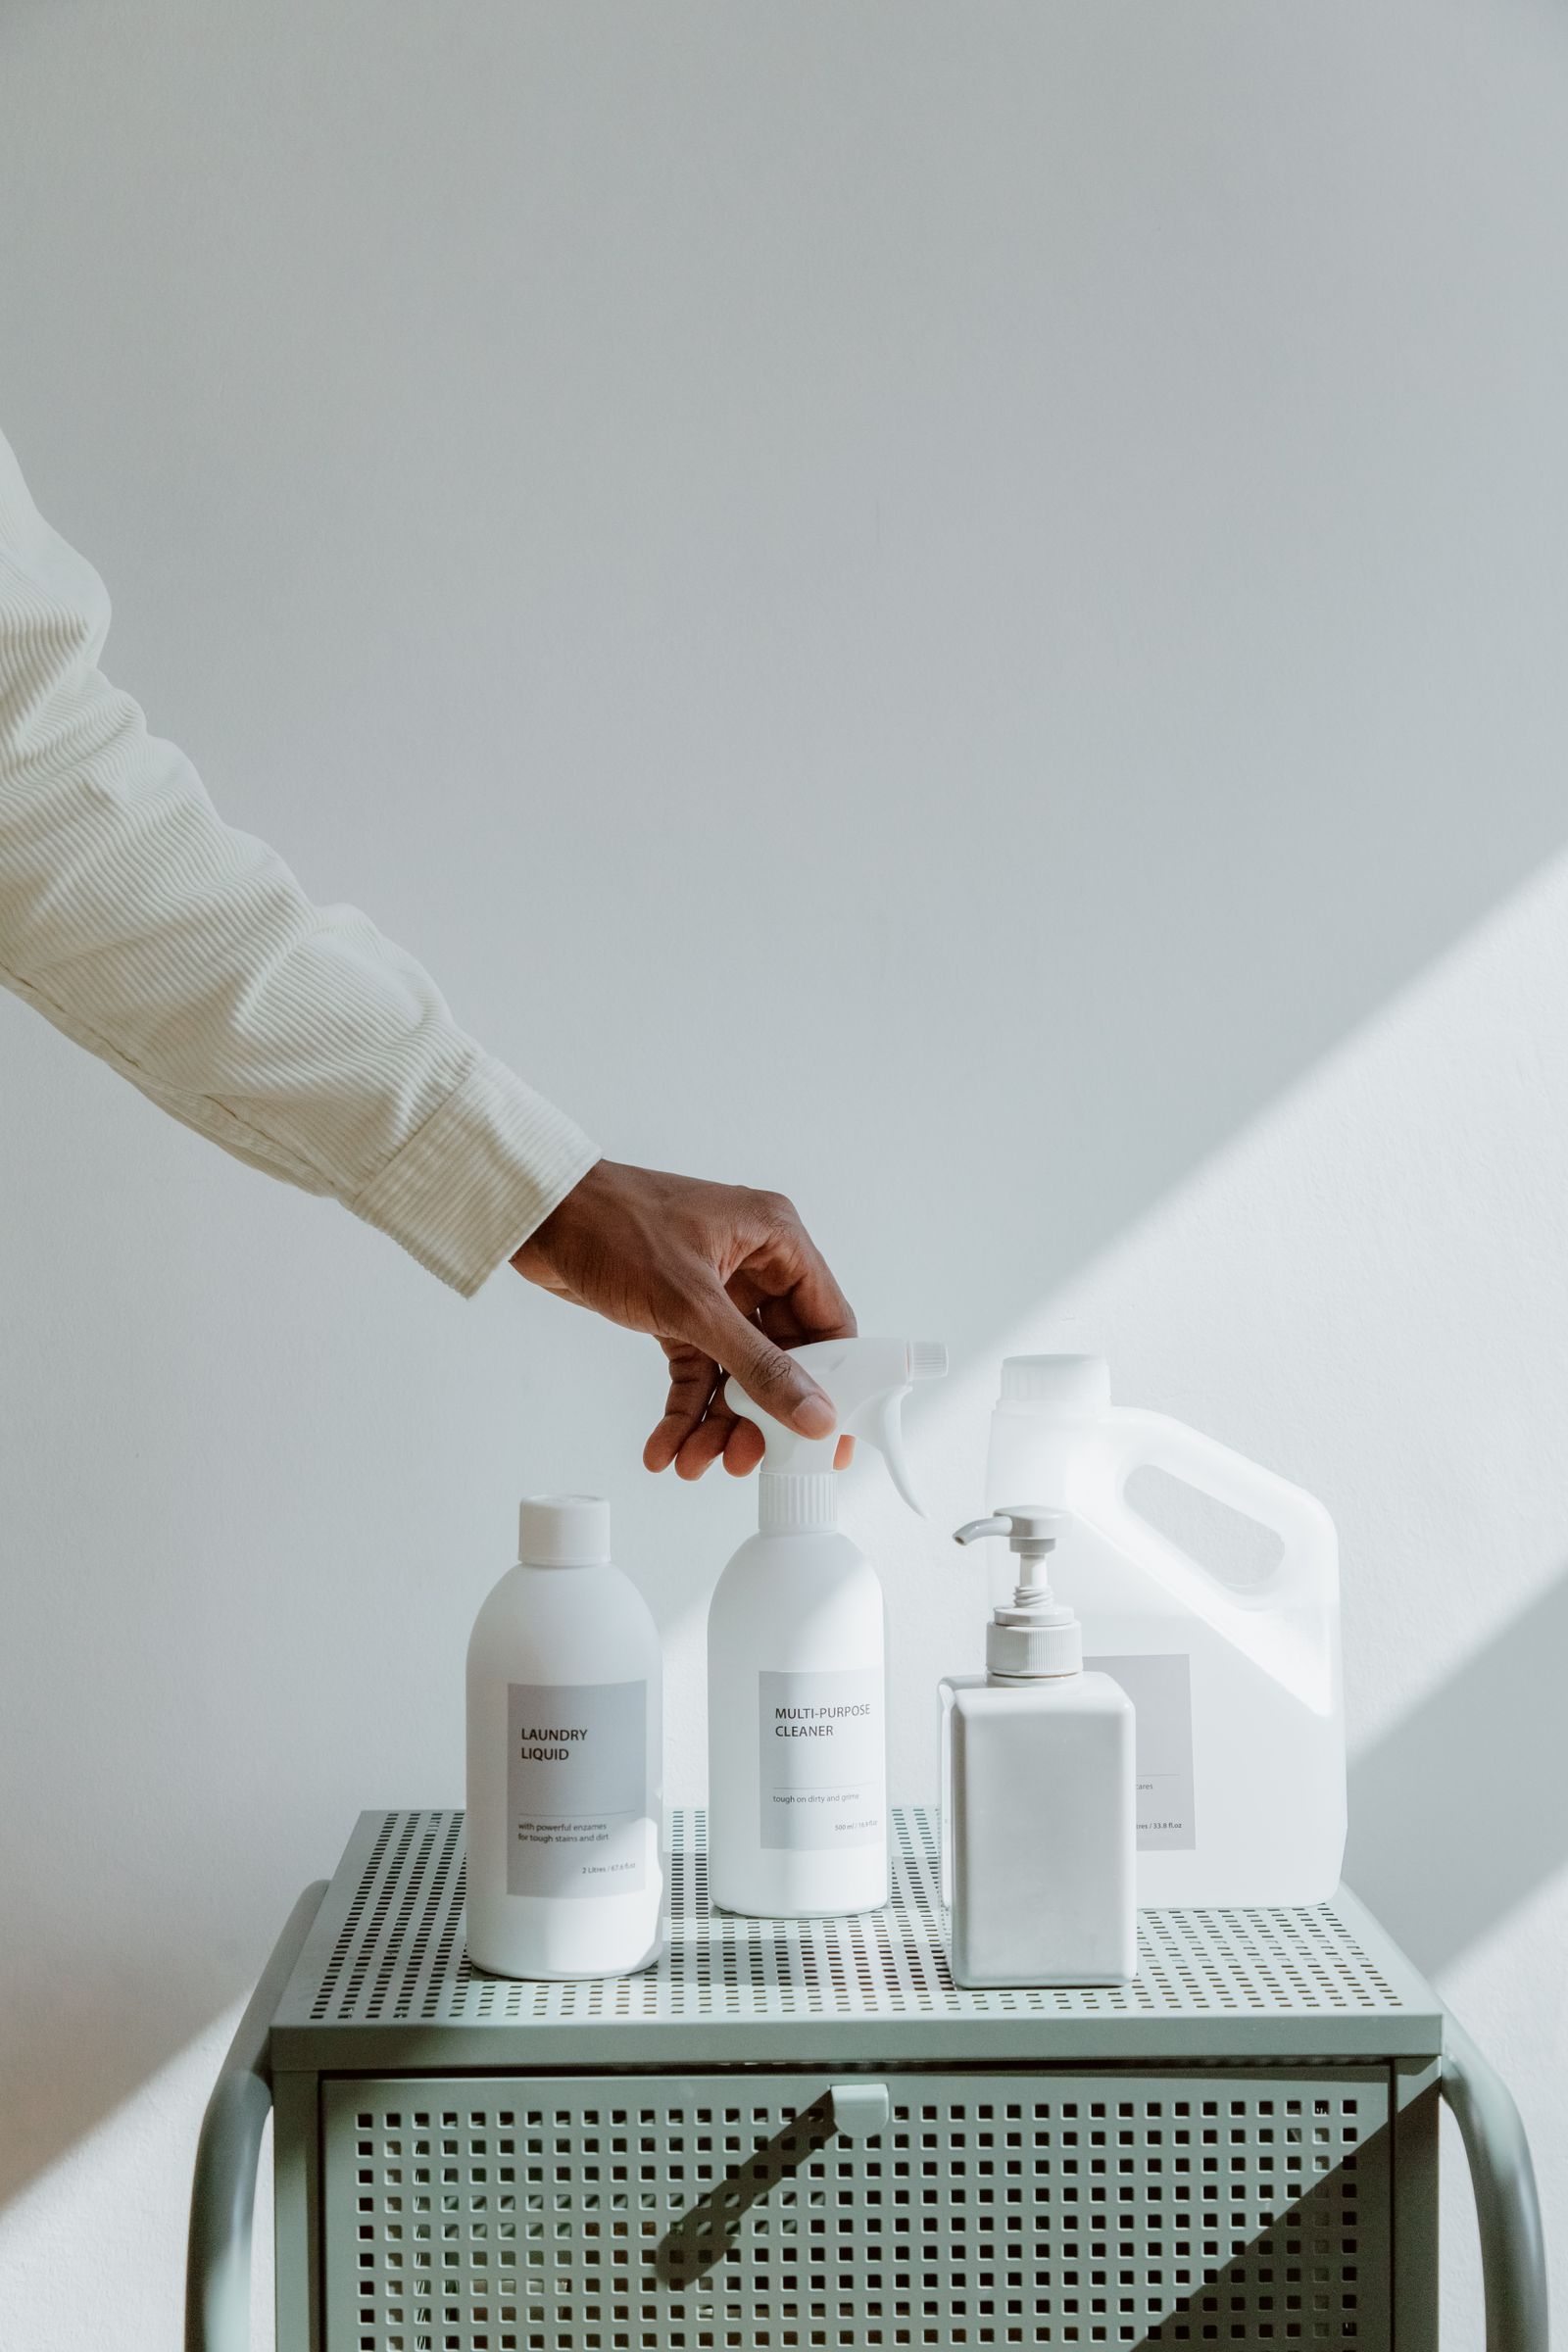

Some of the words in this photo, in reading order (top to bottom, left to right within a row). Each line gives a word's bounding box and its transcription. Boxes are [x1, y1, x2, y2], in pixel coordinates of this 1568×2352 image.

[774, 1703, 871, 1720] MULTI-PURPOSE
[520, 1727, 588, 1741] LAUNDRY
[774, 1725, 834, 1738] CLEANER
[520, 1746, 569, 1762] LIQUID
[772, 1795, 796, 1805] tough
[808, 1794, 825, 1804] dirty
[826, 1793, 840, 1802] and
[536, 1823, 571, 1833] powerful
[517, 1833, 529, 1841] for
[529, 1835, 554, 1843] tough
[578, 1834, 595, 1842] and
[595, 1833, 610, 1841] dirt
